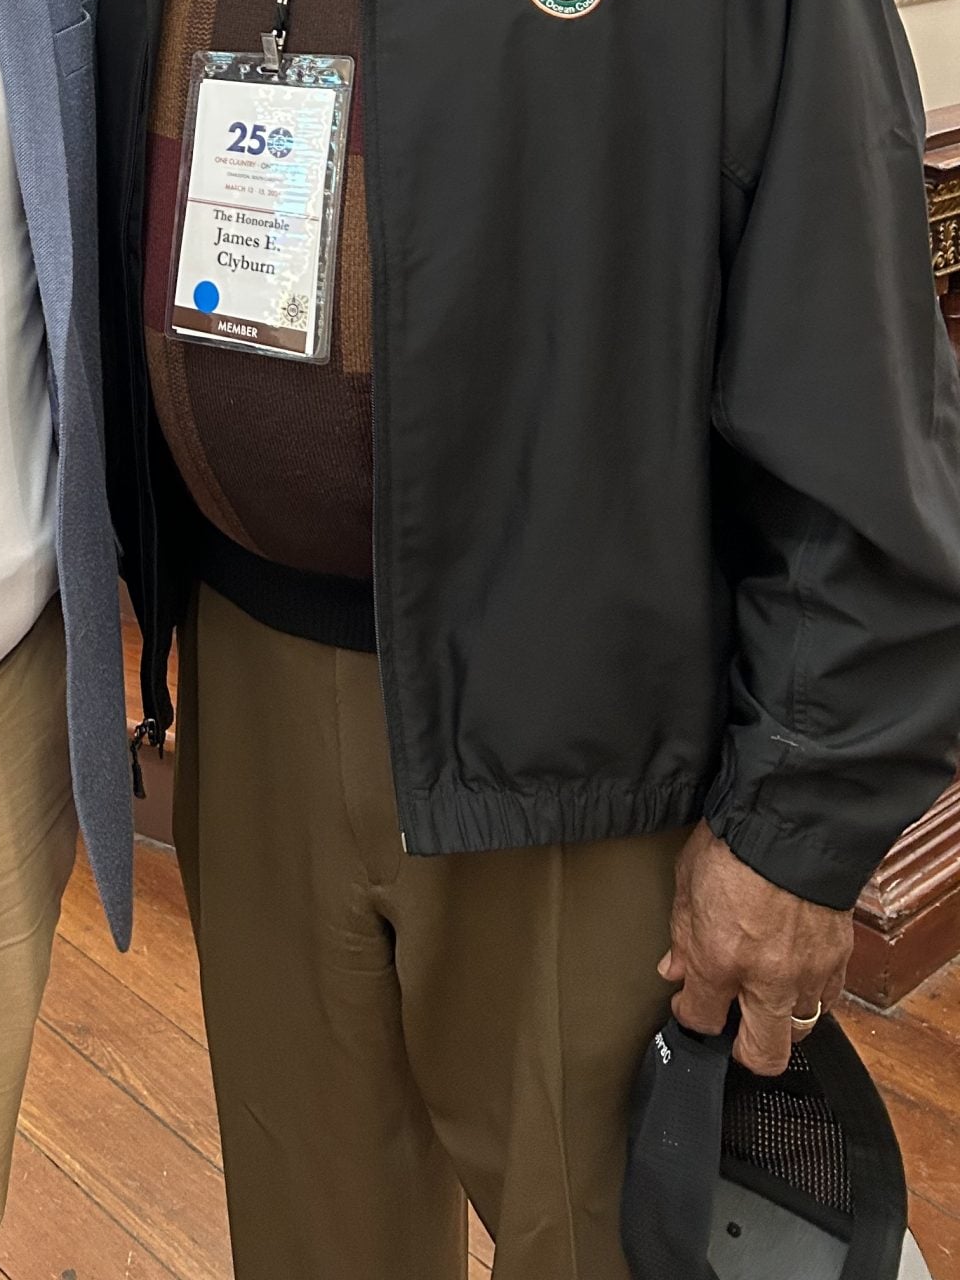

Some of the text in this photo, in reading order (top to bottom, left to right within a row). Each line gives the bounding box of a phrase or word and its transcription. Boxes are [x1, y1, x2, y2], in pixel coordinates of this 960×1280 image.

[545, 0, 576, 13] Ocean
[226, 121, 294, 159] 250
[225, 183, 246, 193] MARCH
[213, 209, 290, 231] The Honorable
[214, 227, 281, 252] James E.
[217, 251, 276, 275] Clyburn
[218, 320, 258, 338] MEMBER
